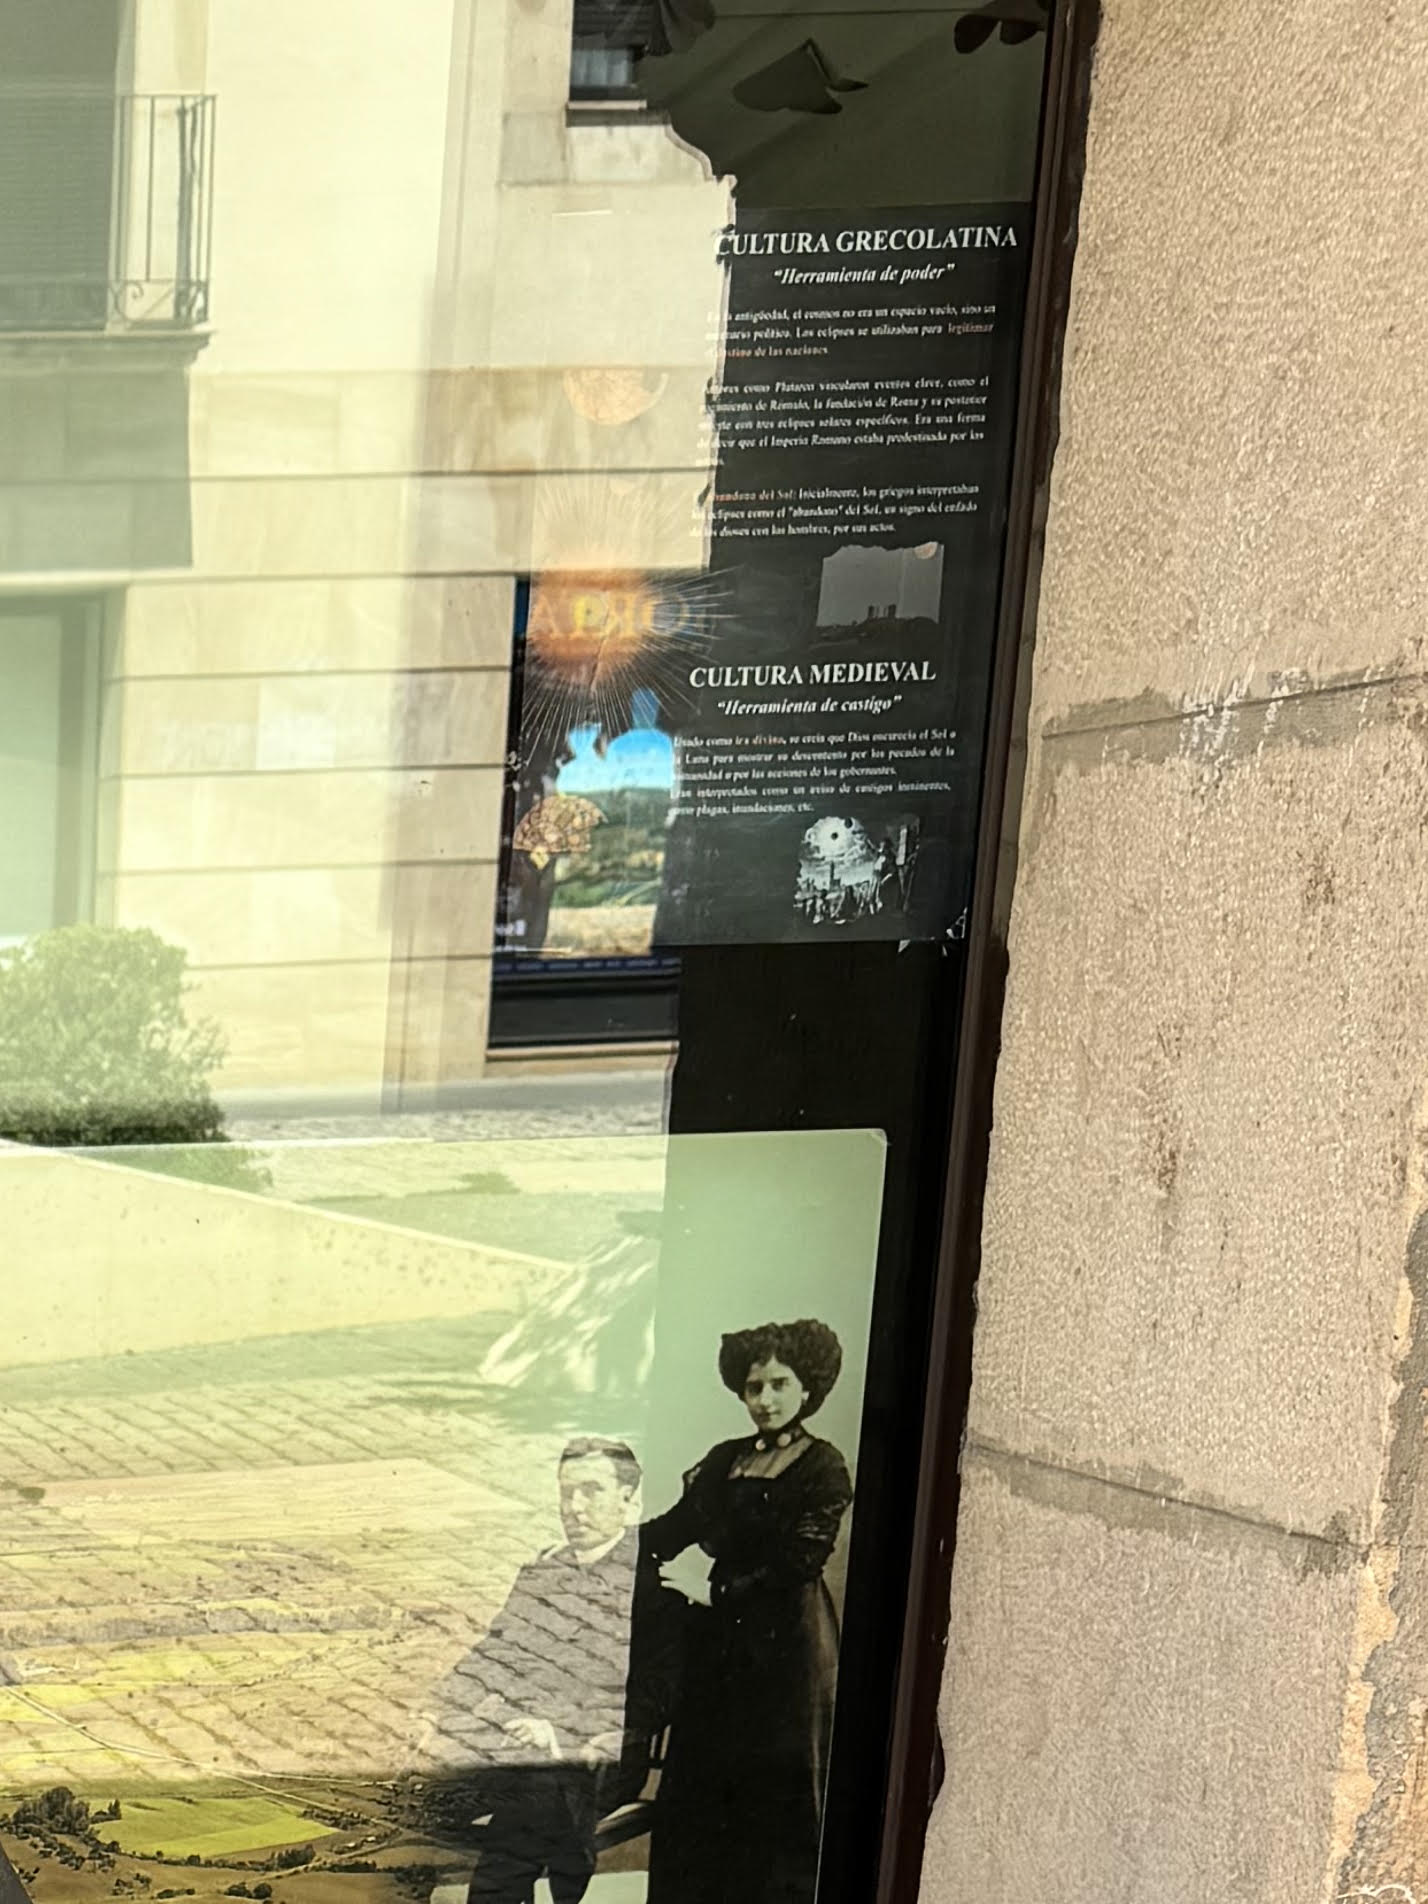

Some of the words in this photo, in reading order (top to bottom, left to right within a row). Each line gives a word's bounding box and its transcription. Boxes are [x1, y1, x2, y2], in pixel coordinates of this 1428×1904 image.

[715, 232, 830, 255] CULTURA
[836, 226, 1018, 251] GRECOLATINA
[880, 265, 898, 281] de
[689, 664, 803, 688] CULTURA
[810, 661, 936, 684] MEDIEVAL
[820, 697, 839, 713] de
